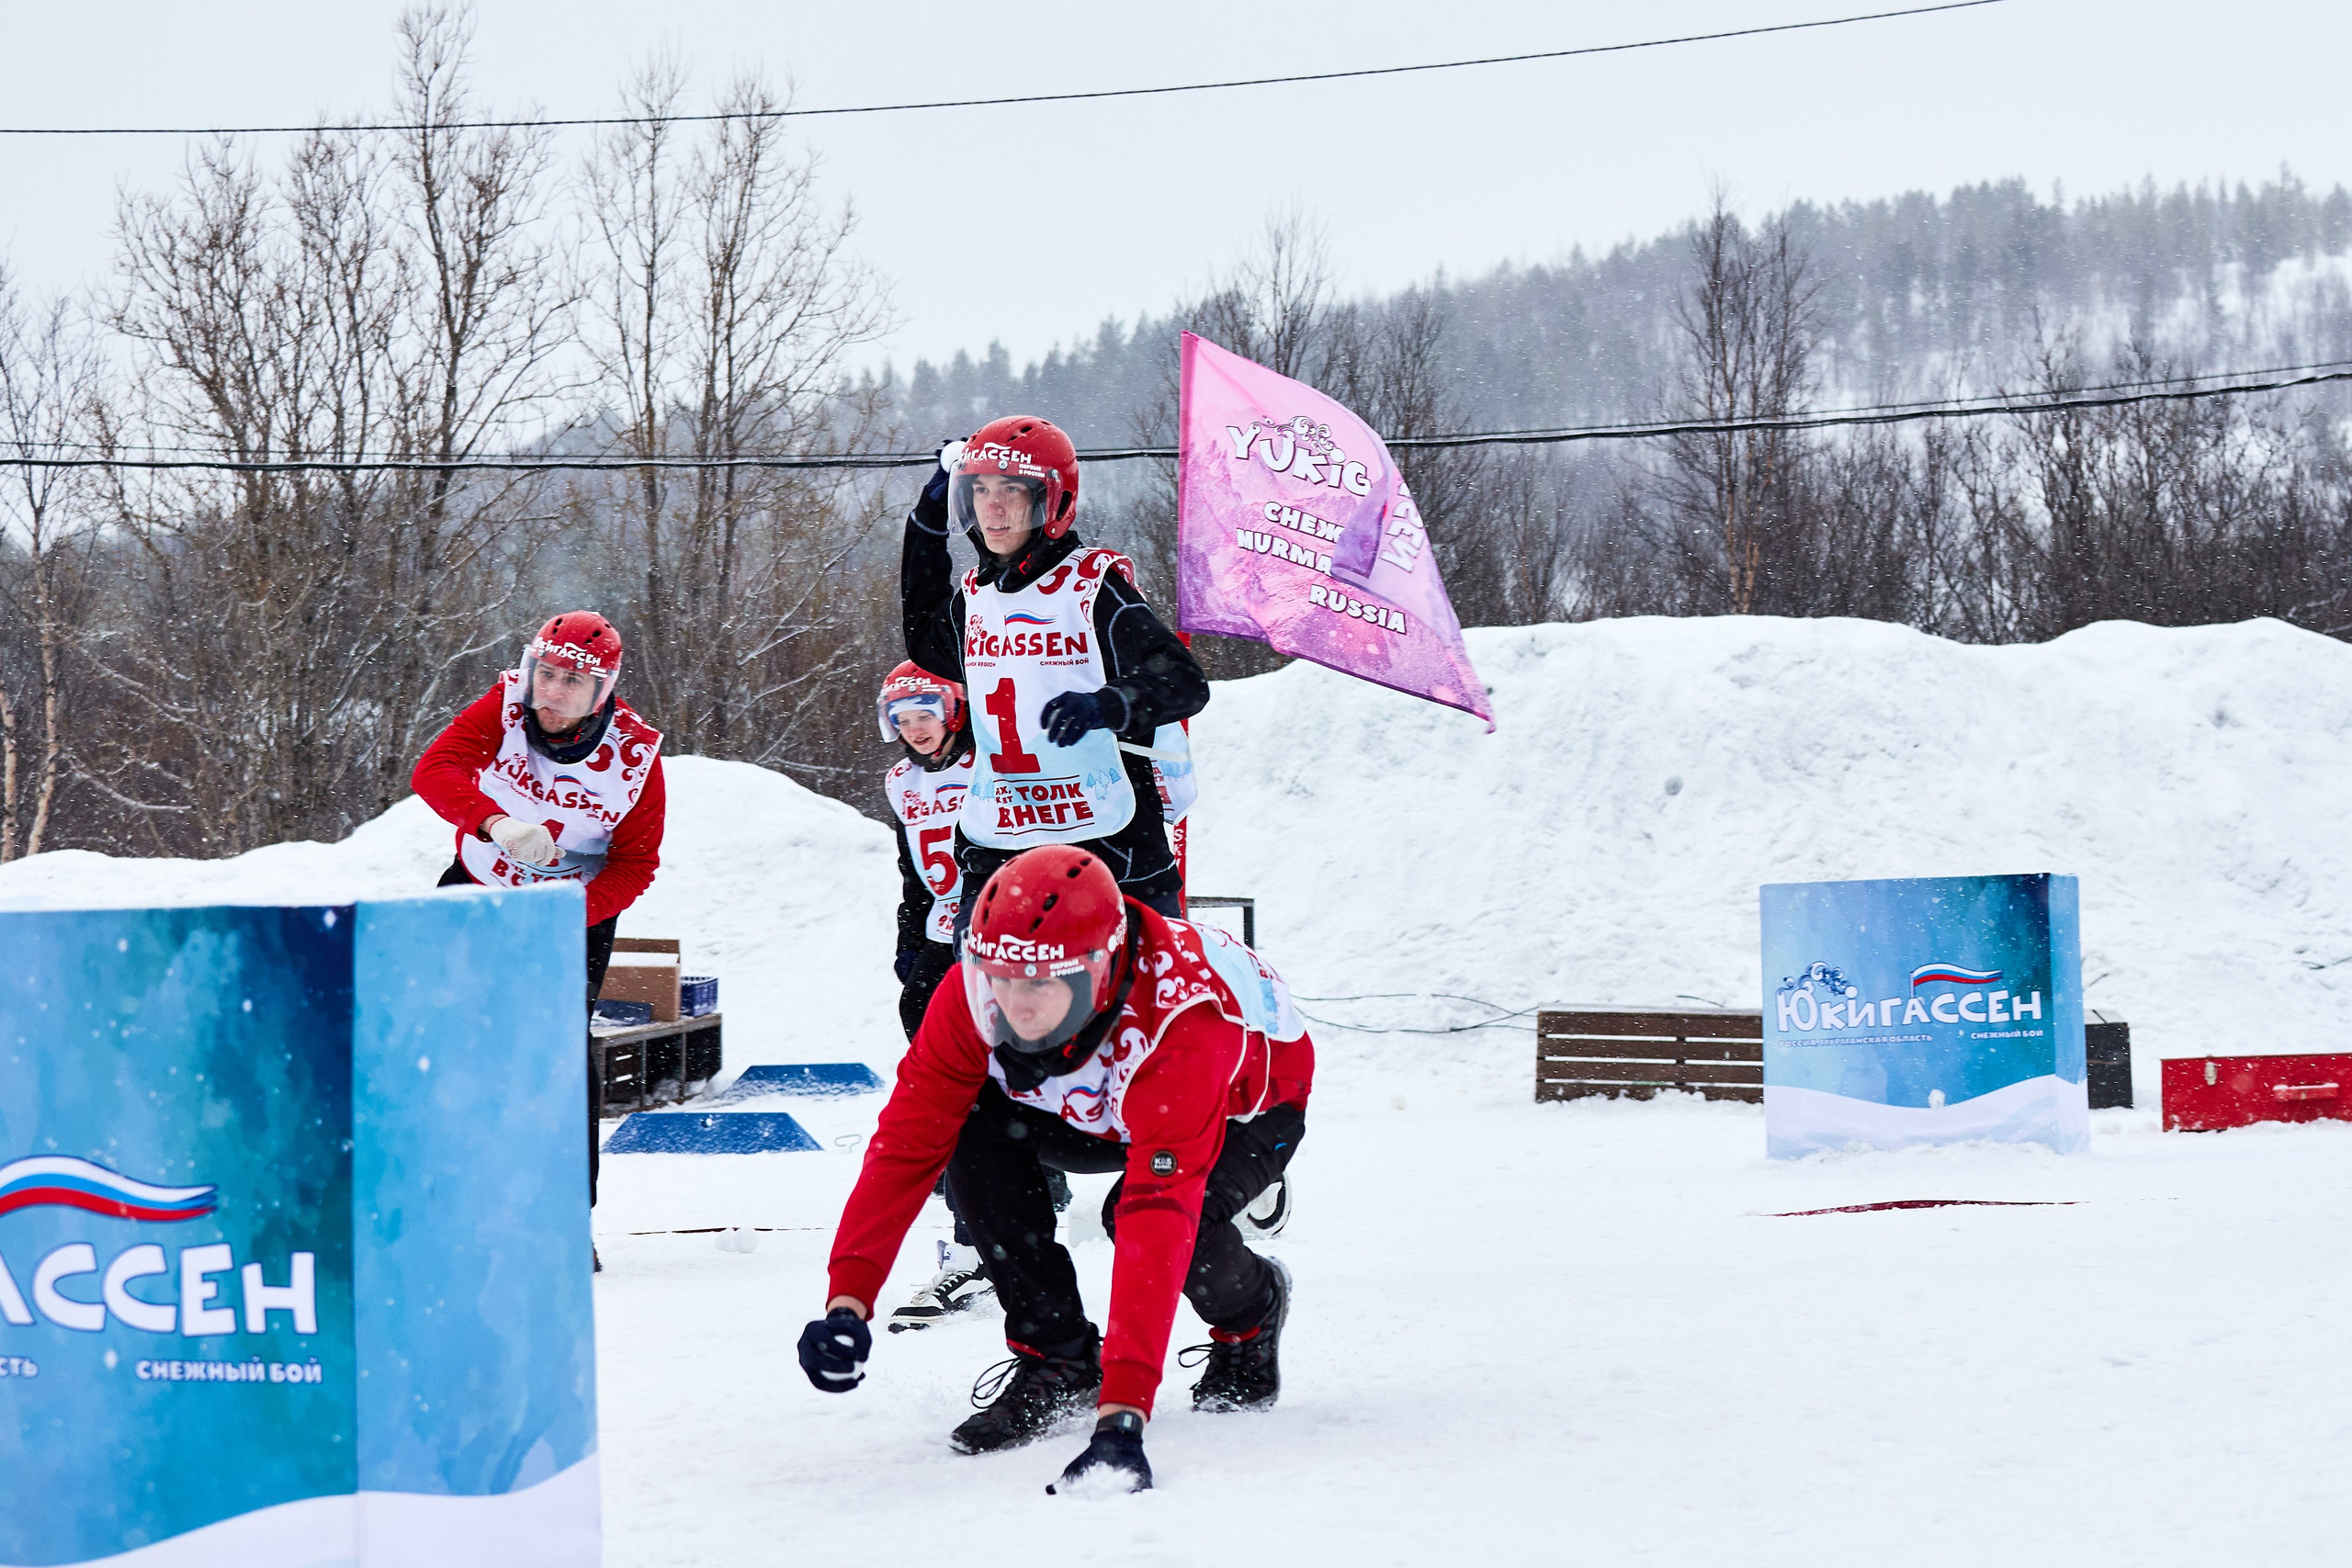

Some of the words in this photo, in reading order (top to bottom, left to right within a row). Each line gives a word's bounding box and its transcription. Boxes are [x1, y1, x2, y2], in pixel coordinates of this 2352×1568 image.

[1309, 584, 1407, 636] RUSSIA
[985, 678, 1041, 773] 1
[1015, 783, 1085, 801] ТОЛК
[920, 825, 958, 897] 5
[1888, 1033, 1933, 1043] ОБЛАСТЬ
[1971, 1028, 2021, 1039] СНЕЖНЫЙ
[2022, 1027, 2043, 1038] БОЙ
[135, 1355, 266, 1382] СНЕЖНЫЙ
[268, 1355, 322, 1384] БОЙ
